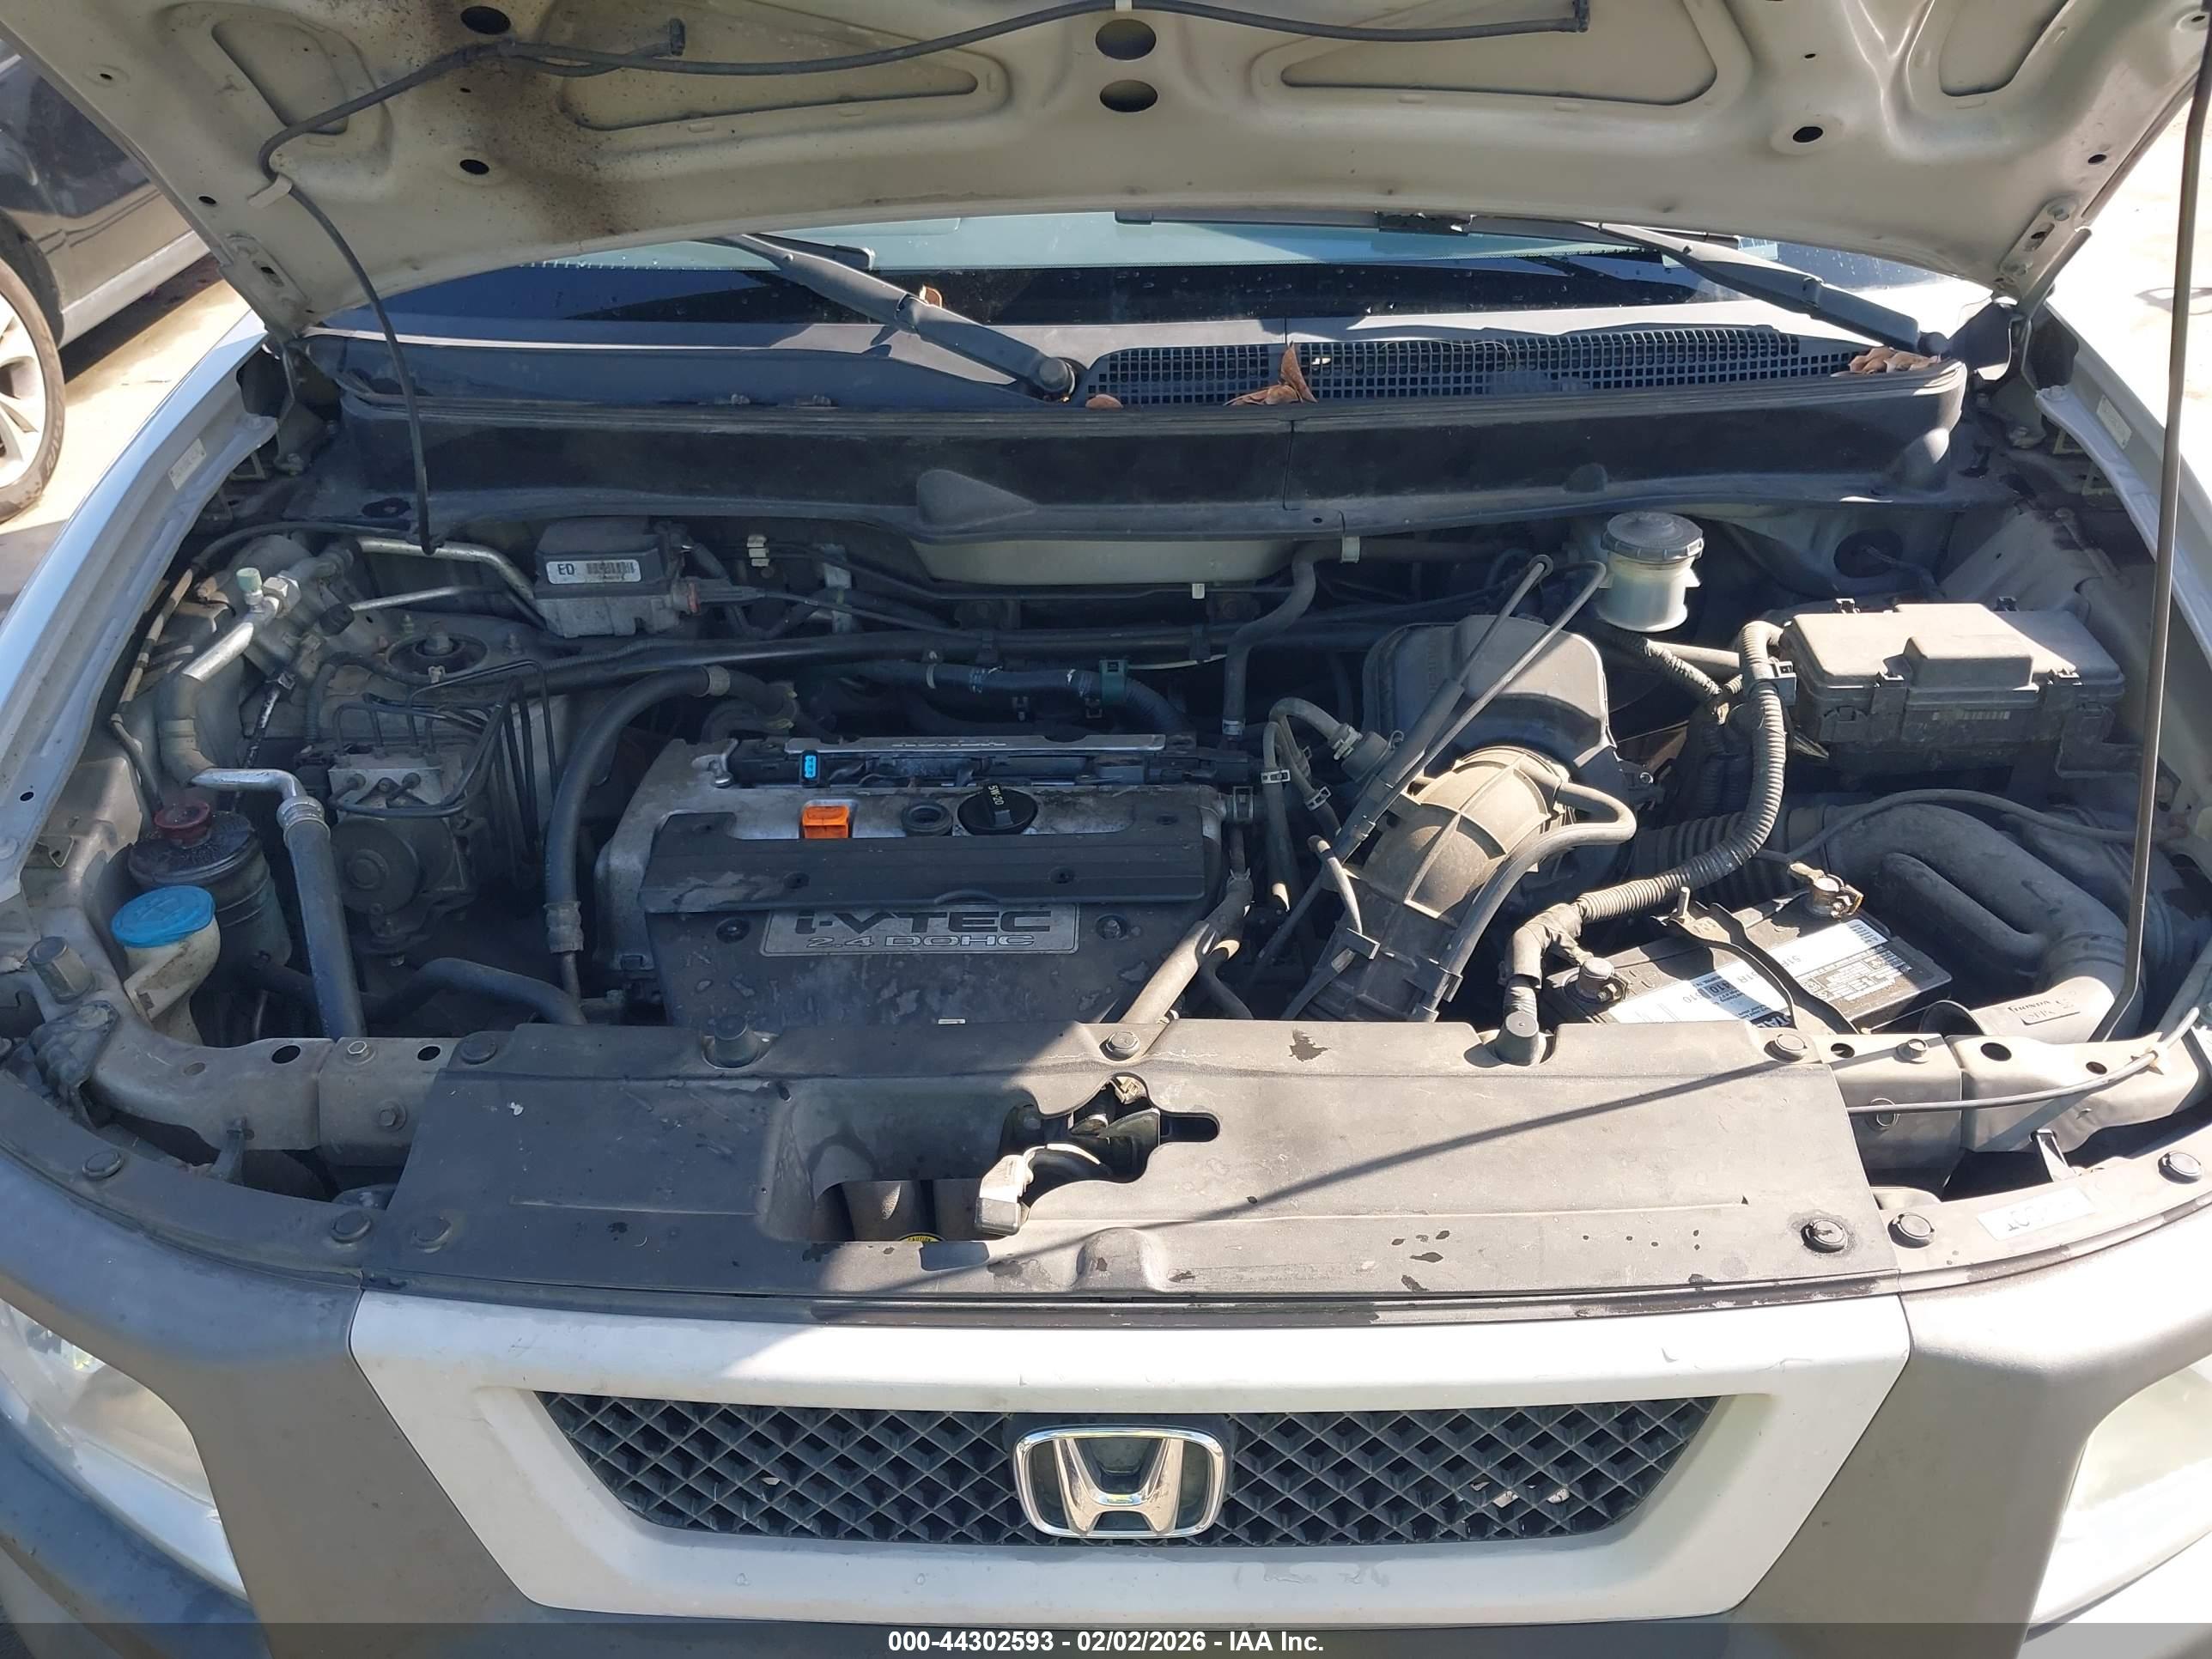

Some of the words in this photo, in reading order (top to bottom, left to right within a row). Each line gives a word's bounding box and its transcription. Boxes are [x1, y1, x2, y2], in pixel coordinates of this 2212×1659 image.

[556, 562, 574, 575] ED
[988, 784, 1005, 805] 5W-20
[794, 909, 1053, 934] i-VTEC
[805, 935, 873, 949] 2.4
[884, 933, 1036, 947] DOHC
